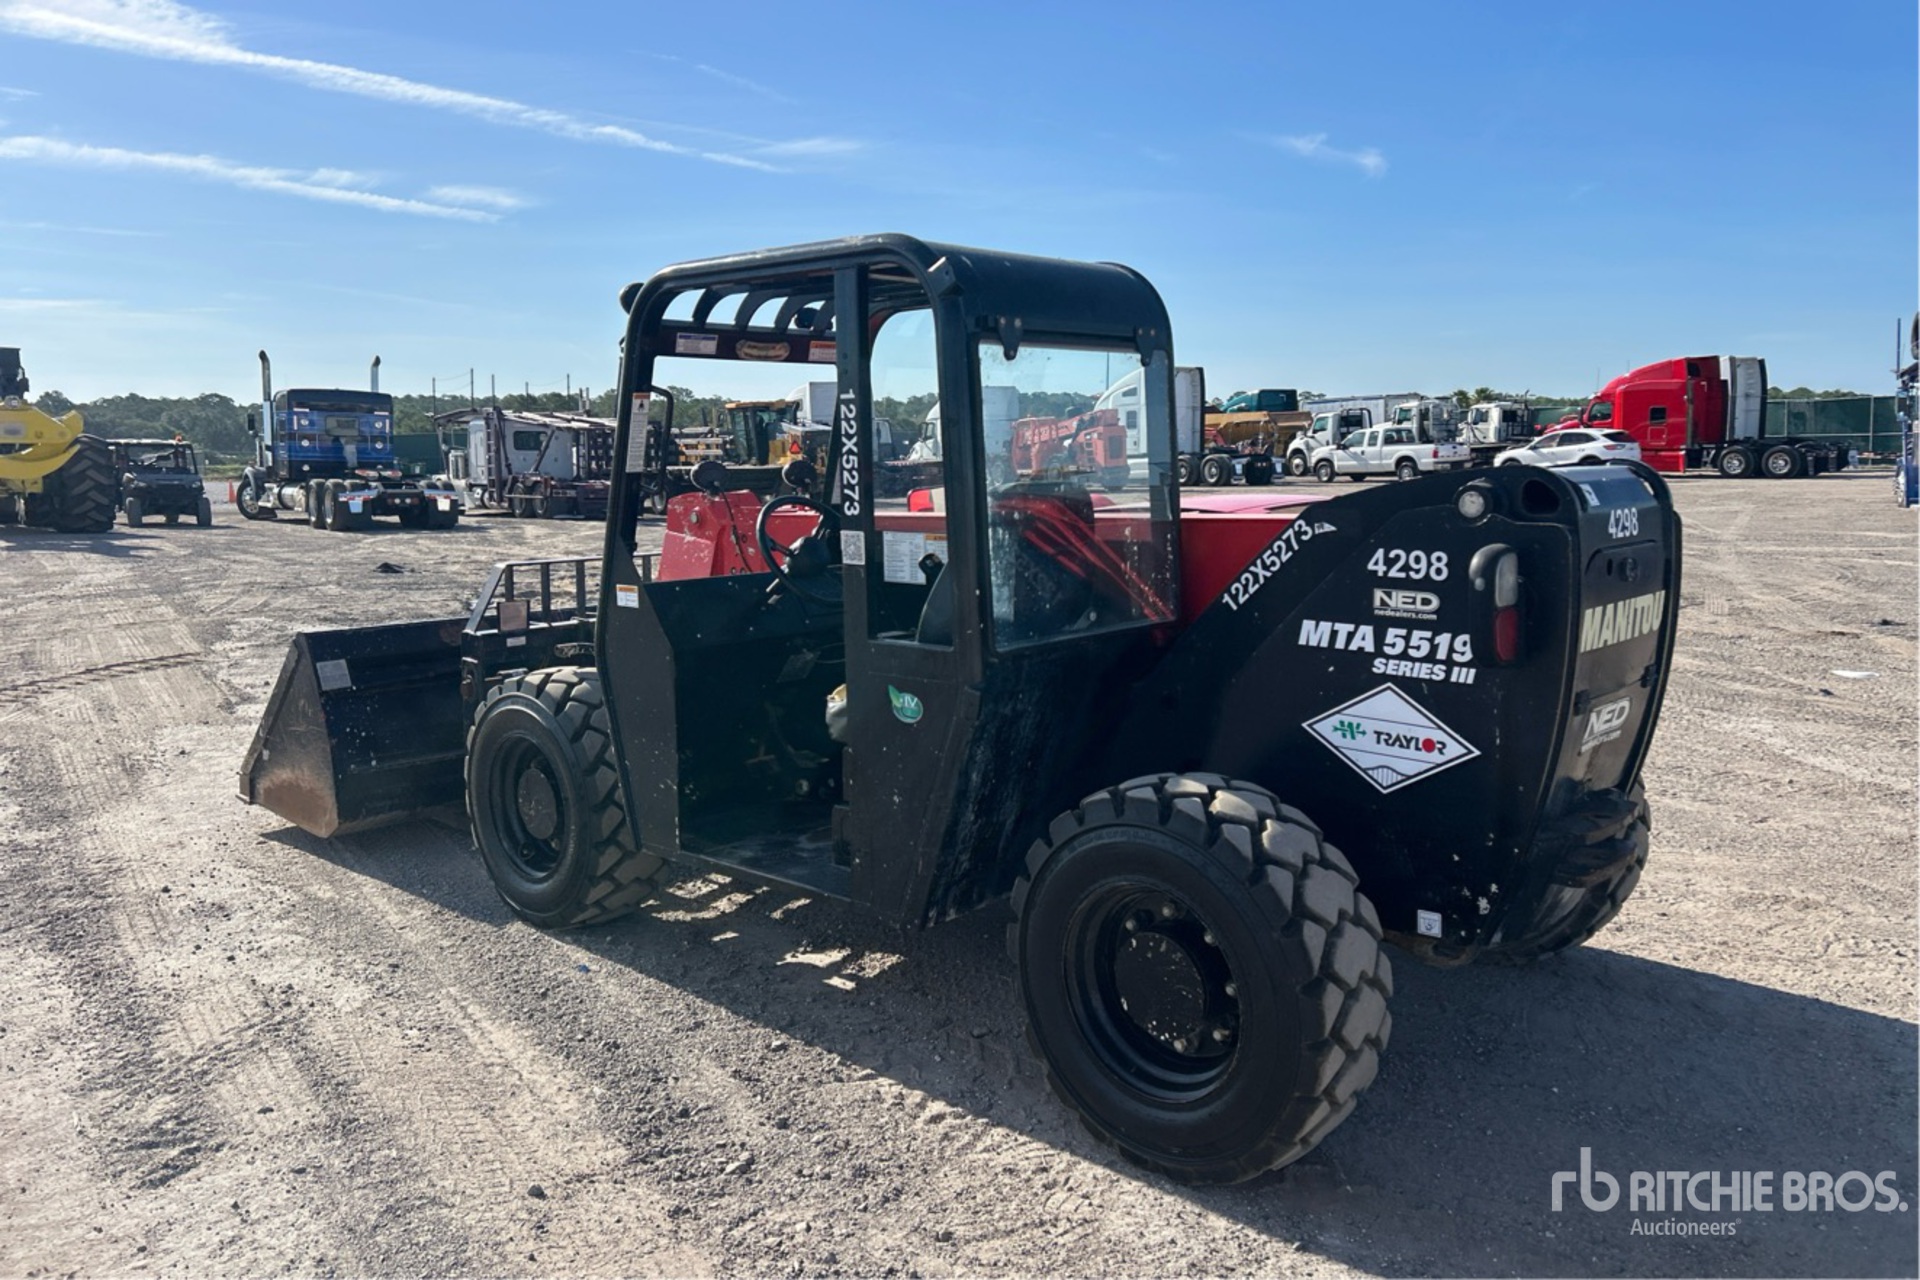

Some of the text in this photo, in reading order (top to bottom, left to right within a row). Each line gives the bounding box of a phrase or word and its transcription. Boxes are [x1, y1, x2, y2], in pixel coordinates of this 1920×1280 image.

[840, 388, 860, 516] 122X5273
[1608, 507, 1639, 539] 4298
[1222, 519, 1313, 611] 122X5273
[1367, 548, 1449, 581] 4298
[1373, 588, 1440, 612] NED
[1374, 608, 1437, 621] nedealers.com
[1580, 590, 1666, 653] MANITOU
[1298, 619, 1473, 663] MTA 5519
[1372, 657, 1477, 684] SERIES III
[1583, 700, 1630, 743] NED
[1373, 730, 1447, 756] TRAYLOR
